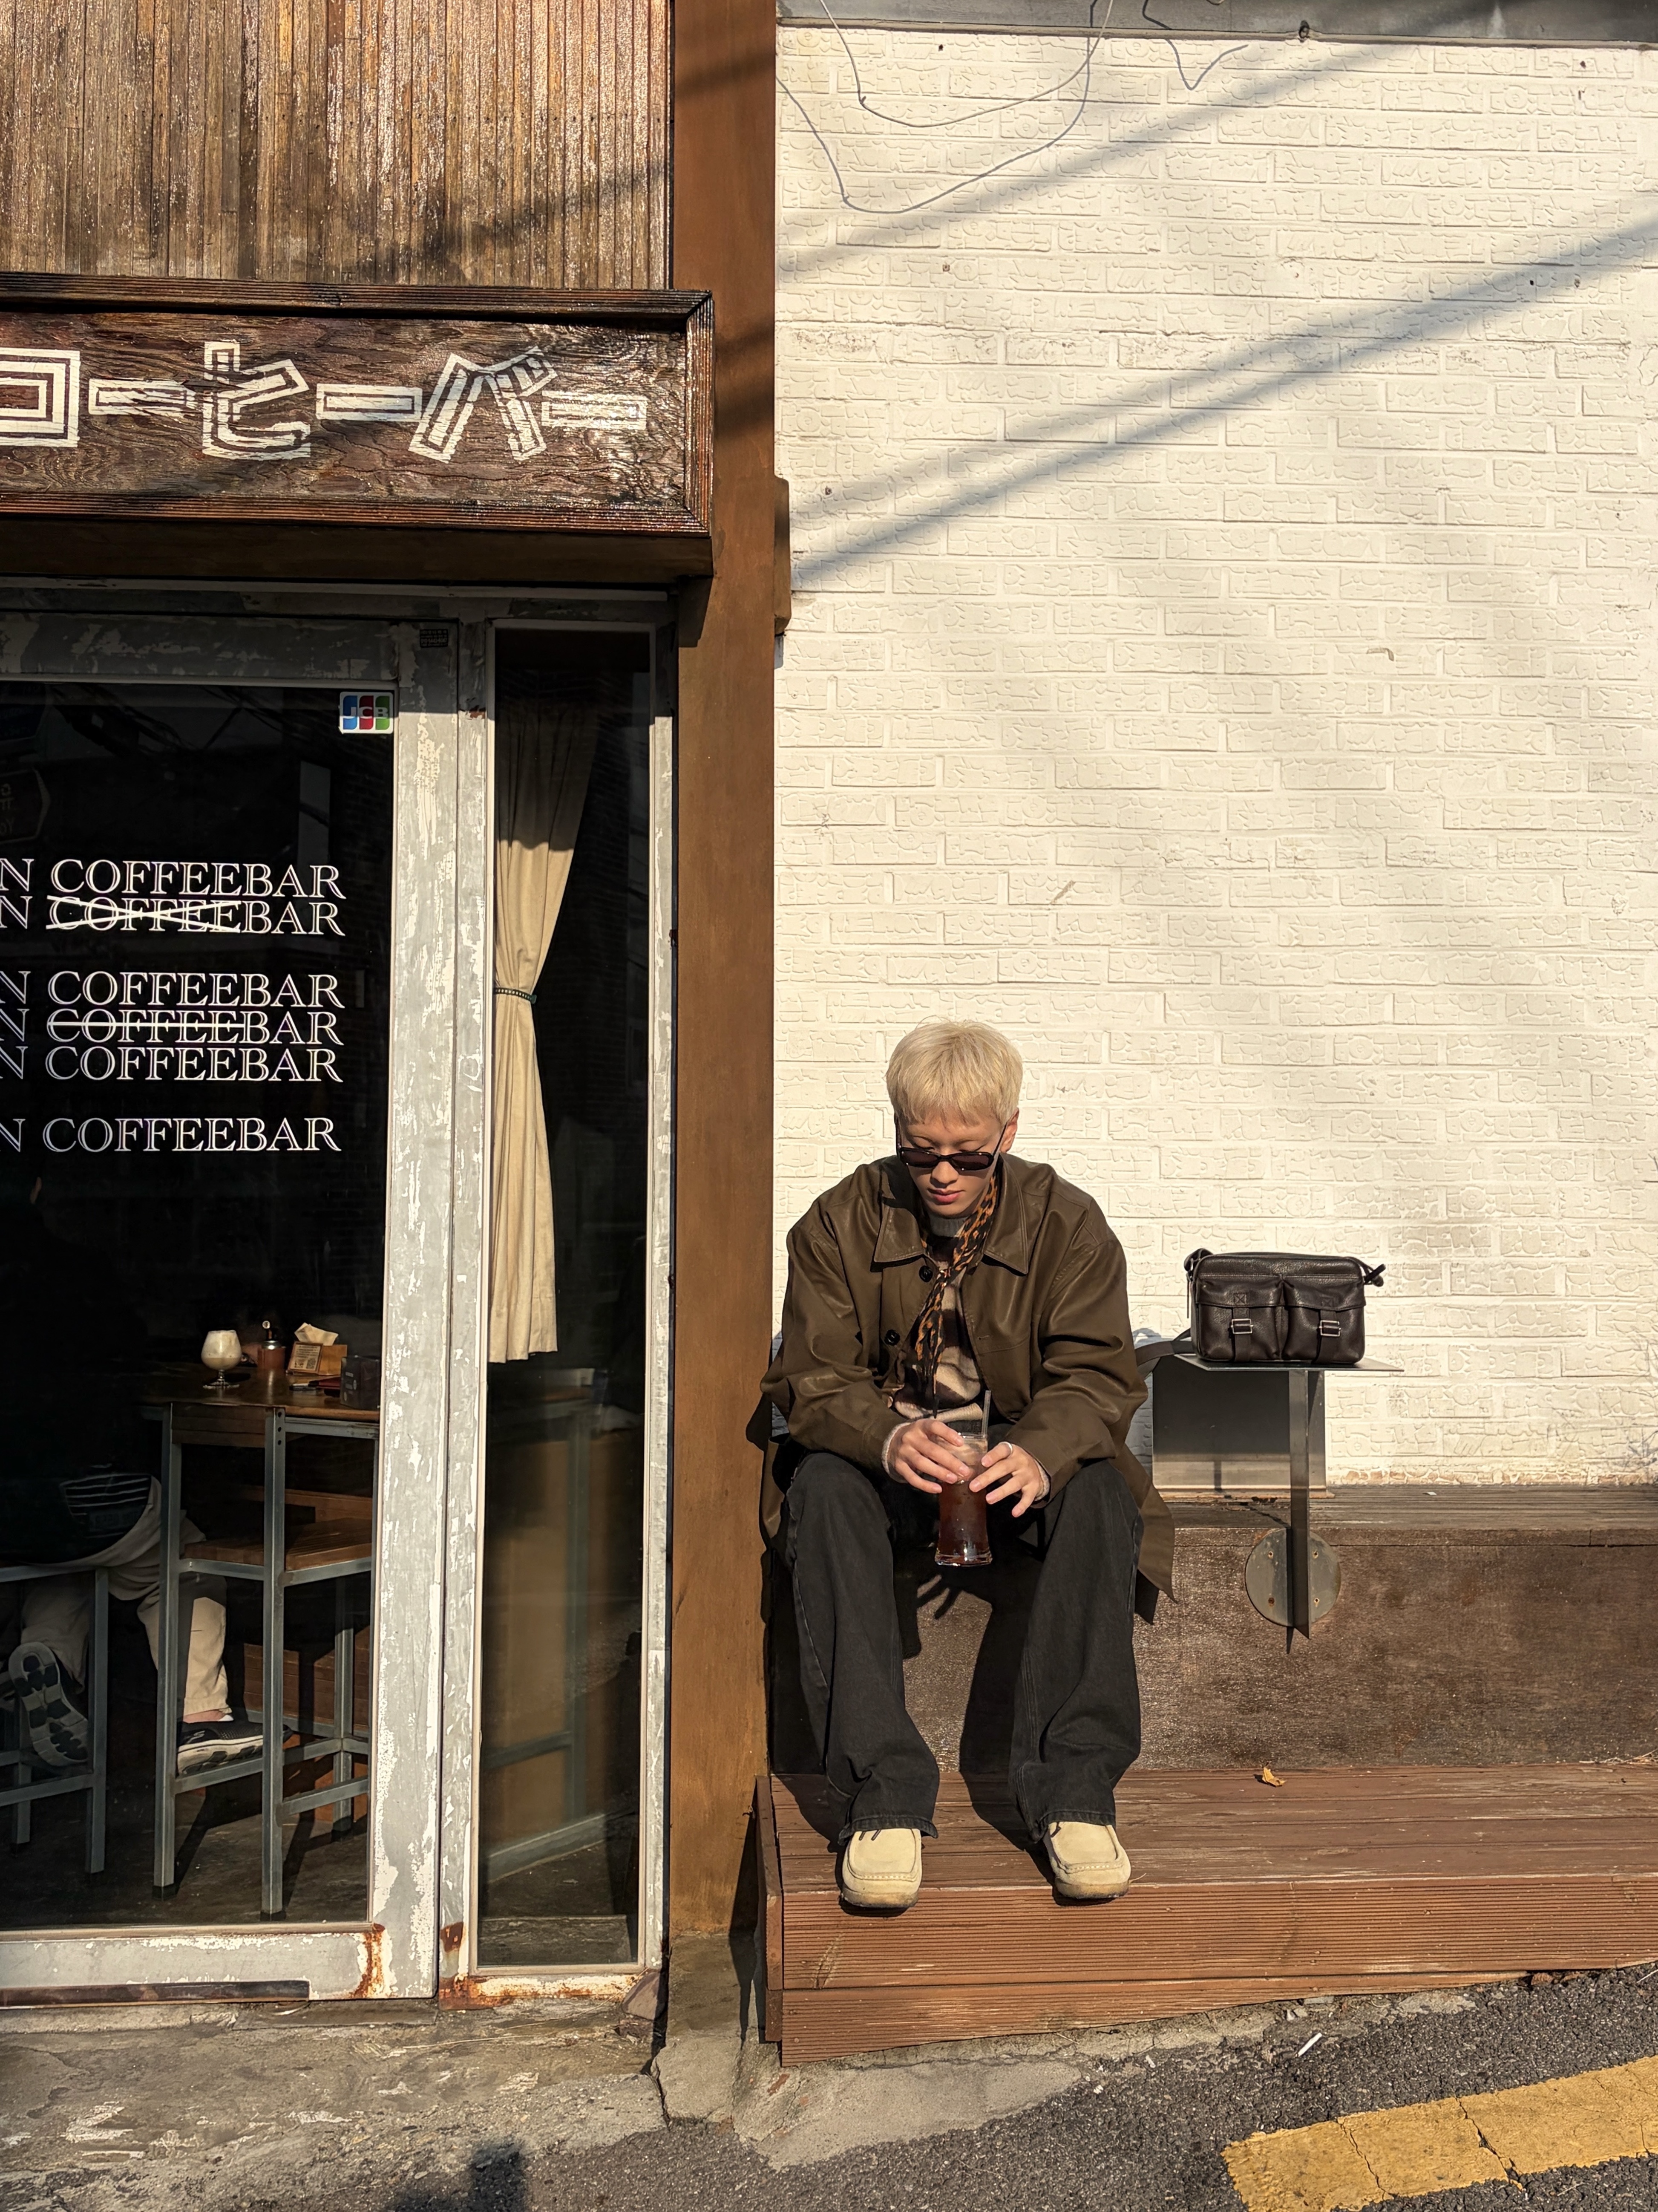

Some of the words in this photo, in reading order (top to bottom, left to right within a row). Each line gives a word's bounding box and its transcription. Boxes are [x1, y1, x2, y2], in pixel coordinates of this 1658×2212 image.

[343, 706, 388, 719] JCB
[51, 859, 346, 899] COFFEEBAR
[49, 897, 345, 936] COFFEEBAR
[48, 971, 345, 1008] COFFEEBAR
[46, 1008, 344, 1045] COFFEEBAR
[45, 1046, 343, 1082] COFFEEBAR
[43, 1117, 341, 1152] COFFEEBAR
